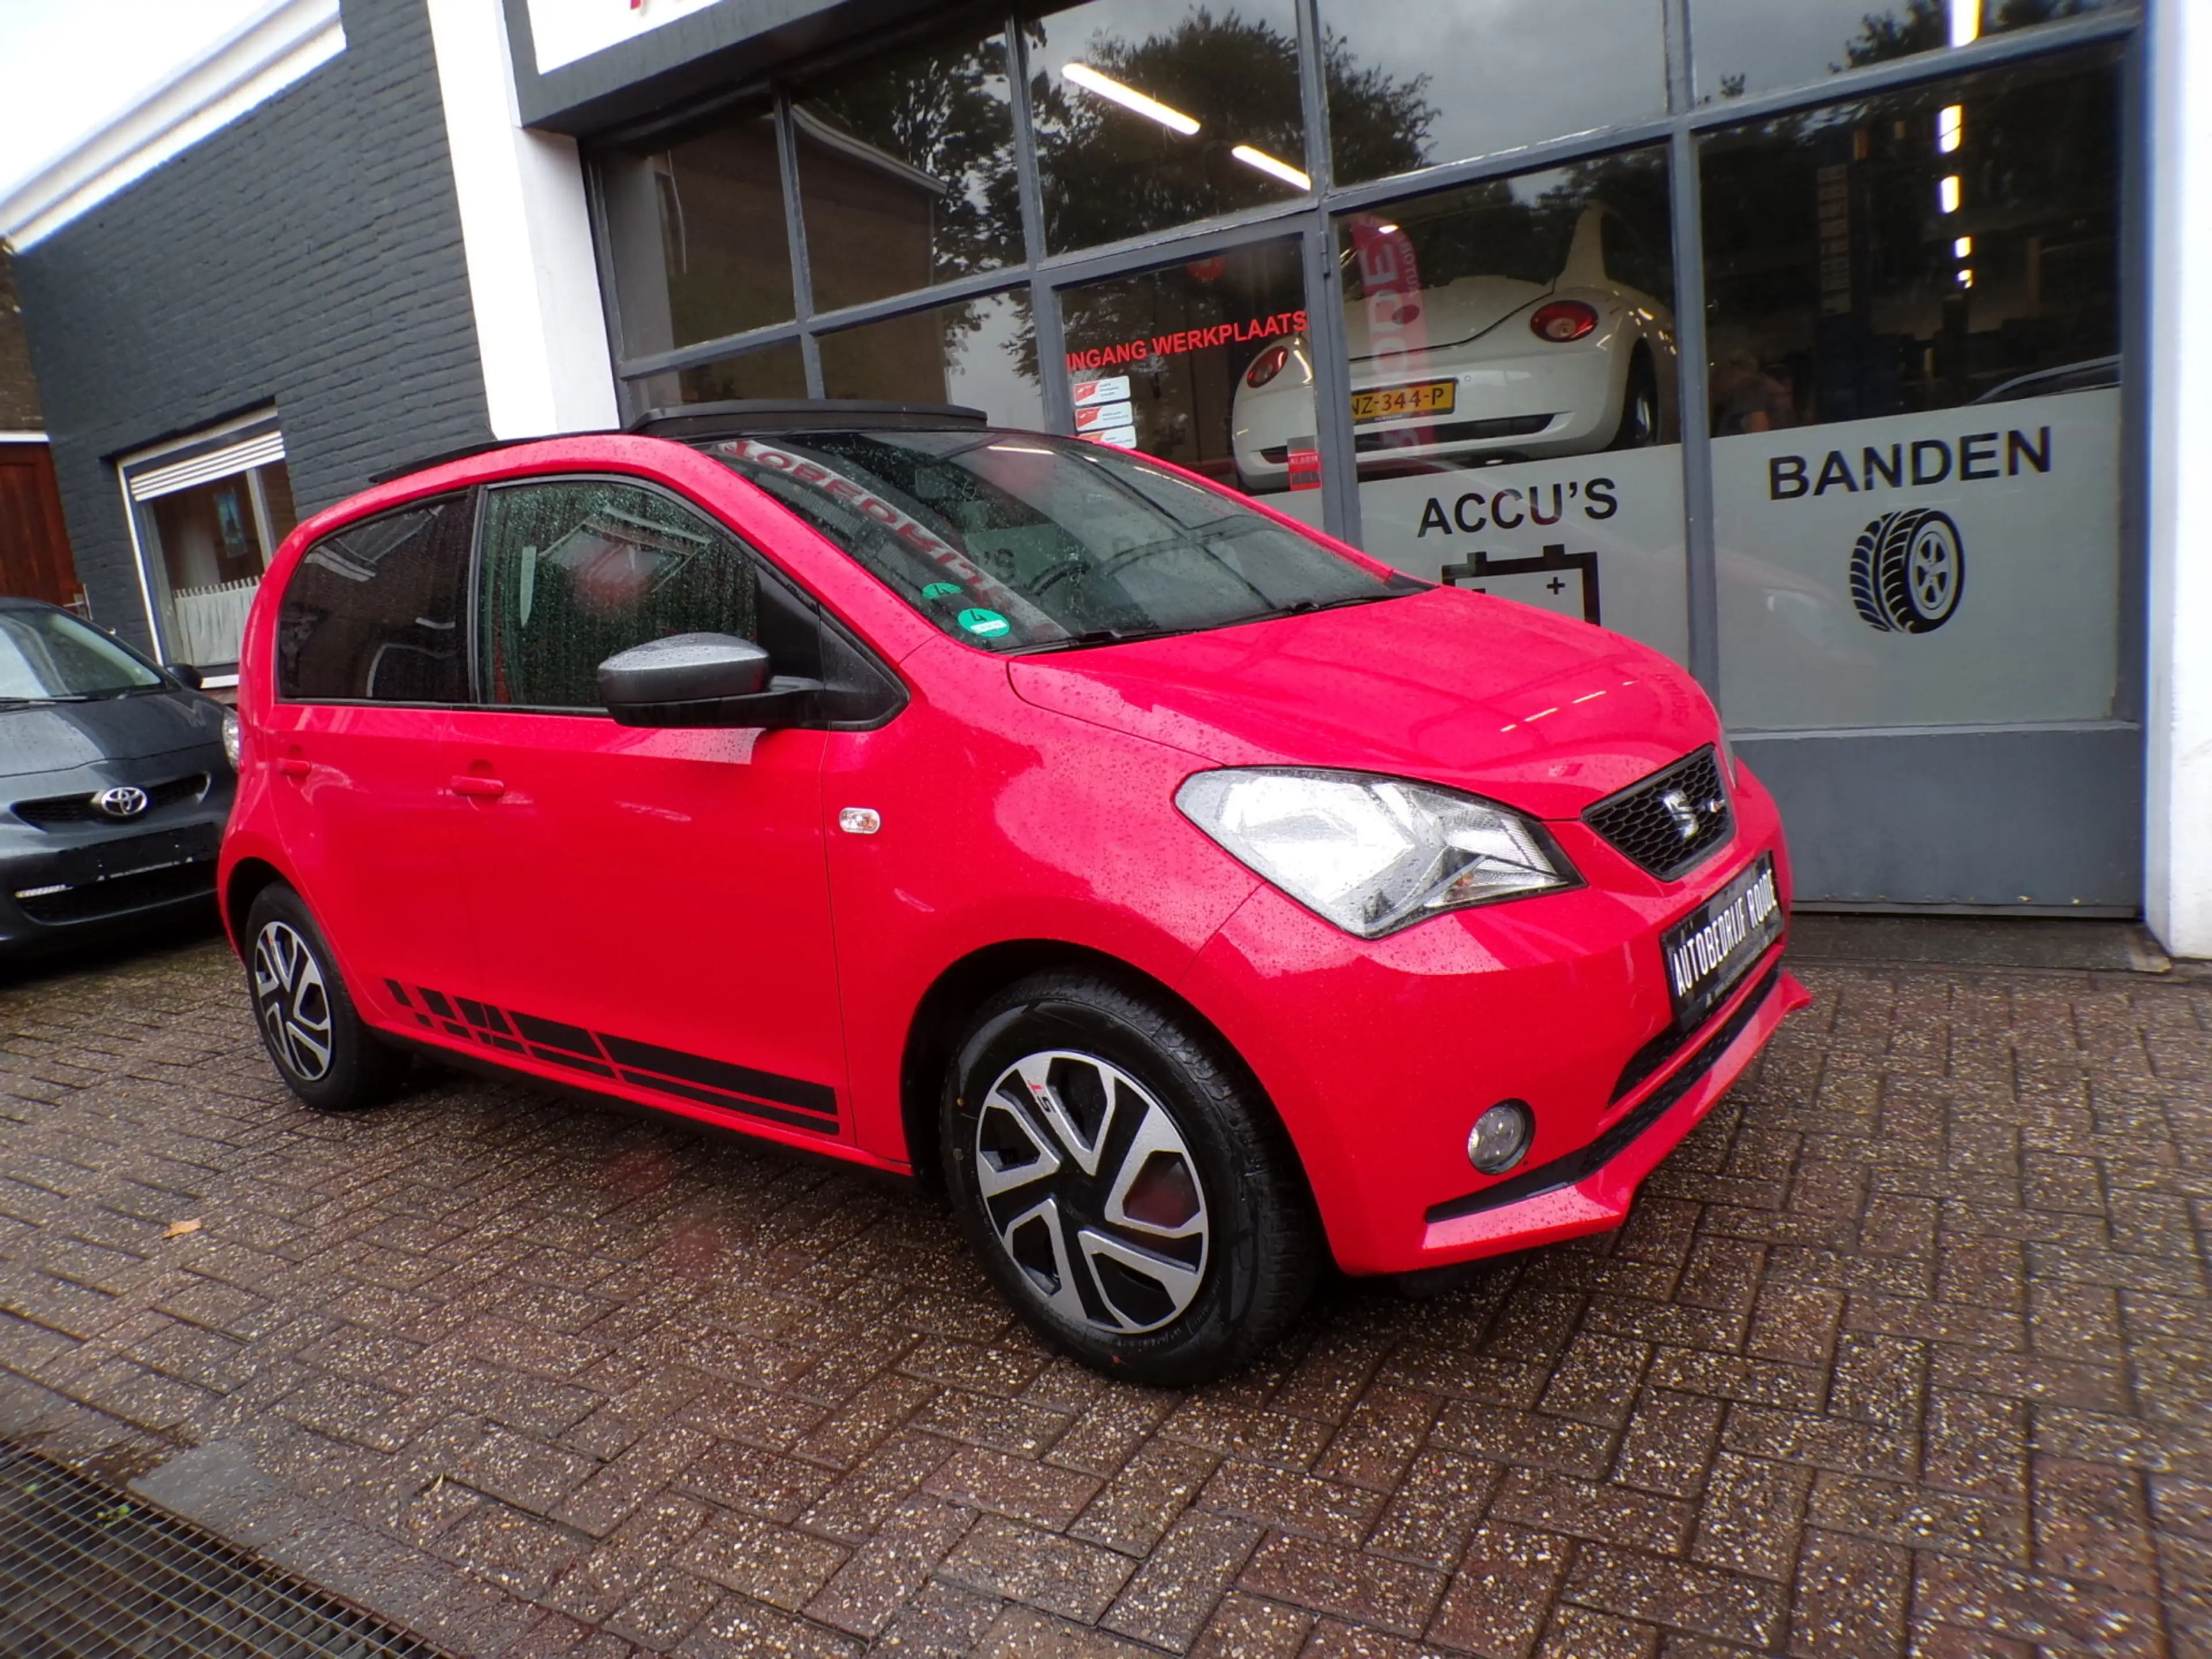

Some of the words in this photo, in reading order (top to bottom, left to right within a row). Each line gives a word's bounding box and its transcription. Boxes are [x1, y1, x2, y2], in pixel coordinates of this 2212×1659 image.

[1066, 341, 1147, 372] INGANG
[1152, 310, 1308, 355] WERKPLAATS
[1769, 426, 2051, 500] BANDEN
[1673, 897, 1745, 997] AUTOBEDRIJF
